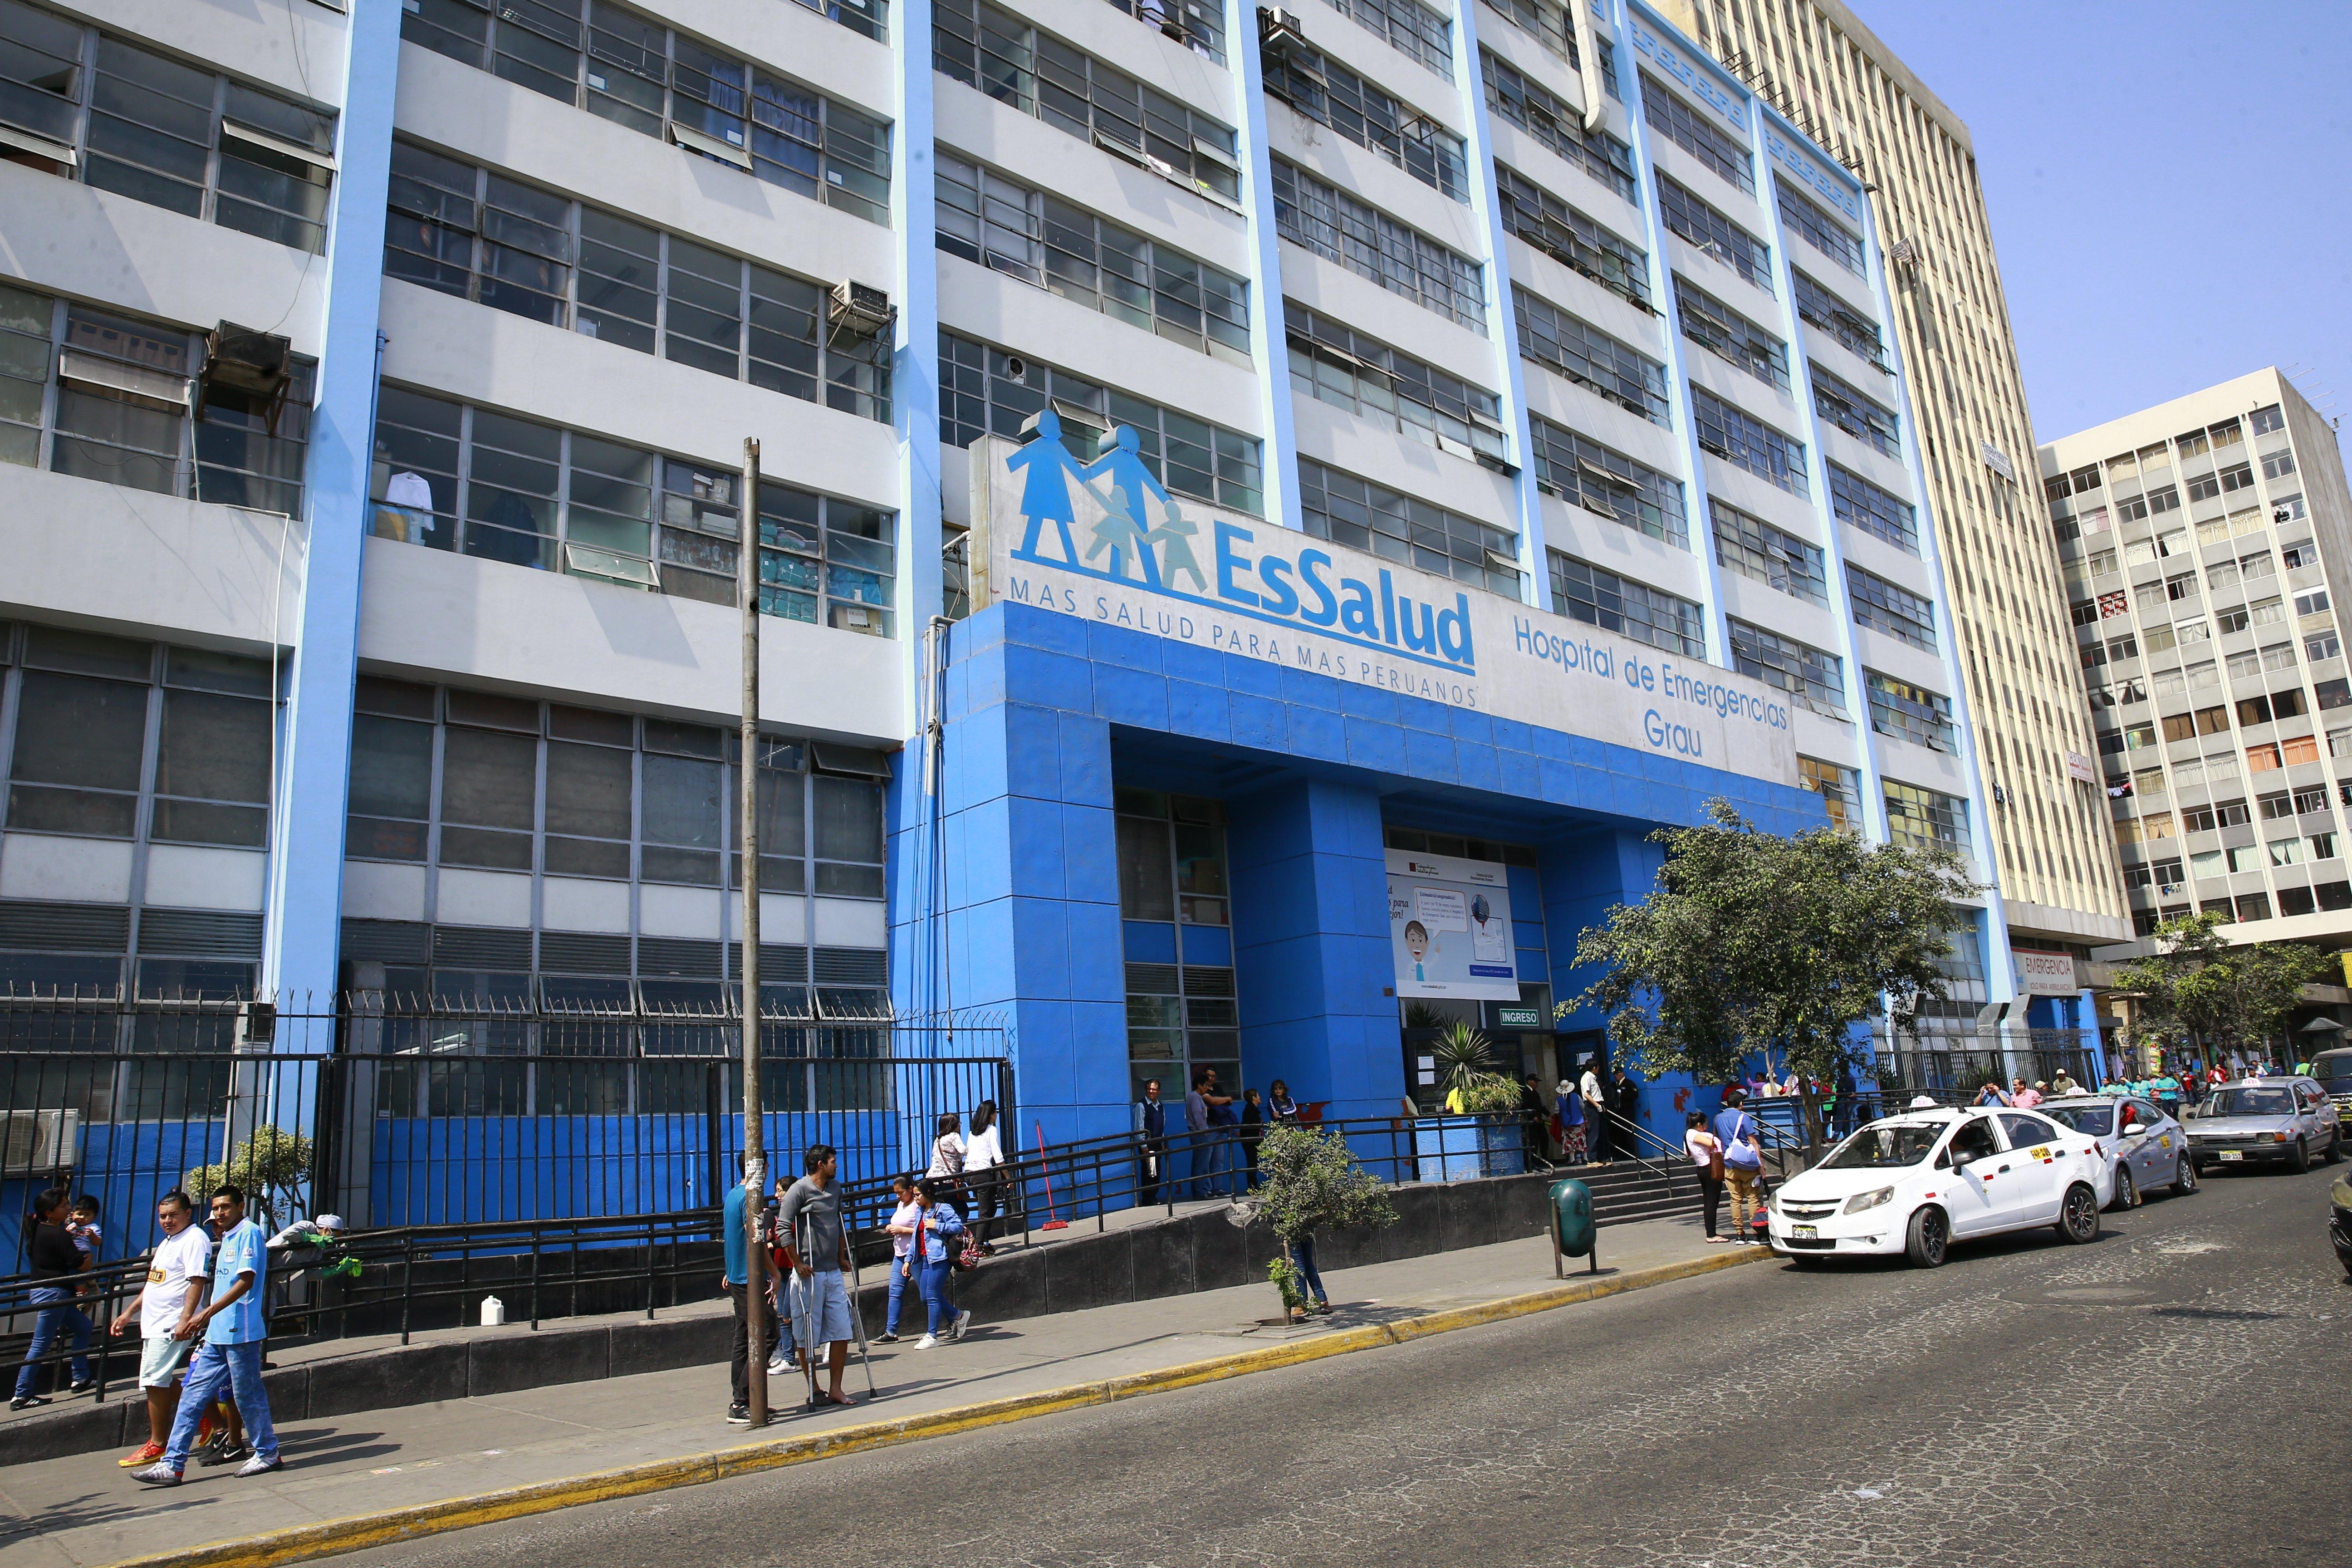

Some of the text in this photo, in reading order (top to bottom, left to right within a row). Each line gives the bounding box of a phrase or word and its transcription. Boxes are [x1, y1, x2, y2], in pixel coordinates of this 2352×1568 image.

[1214, 520, 1475, 666] EsSalud
[1011, 577, 1475, 707] MAS SALUD PARA MAS PERUANOS
[1513, 616, 1787, 730] Hospital de Emergencias
[1644, 709, 1702, 758] Grau
[1393, 899, 1409, 909] para
[1389, 909, 1403, 920] ejor!
[2026, 957, 2072, 975] EMERGENCIA
[1502, 1012, 1537, 1023] INGRESO
[2030, 1147, 2051, 1158] F4P-209
[1794, 1229, 1815, 1239] F4P-209
